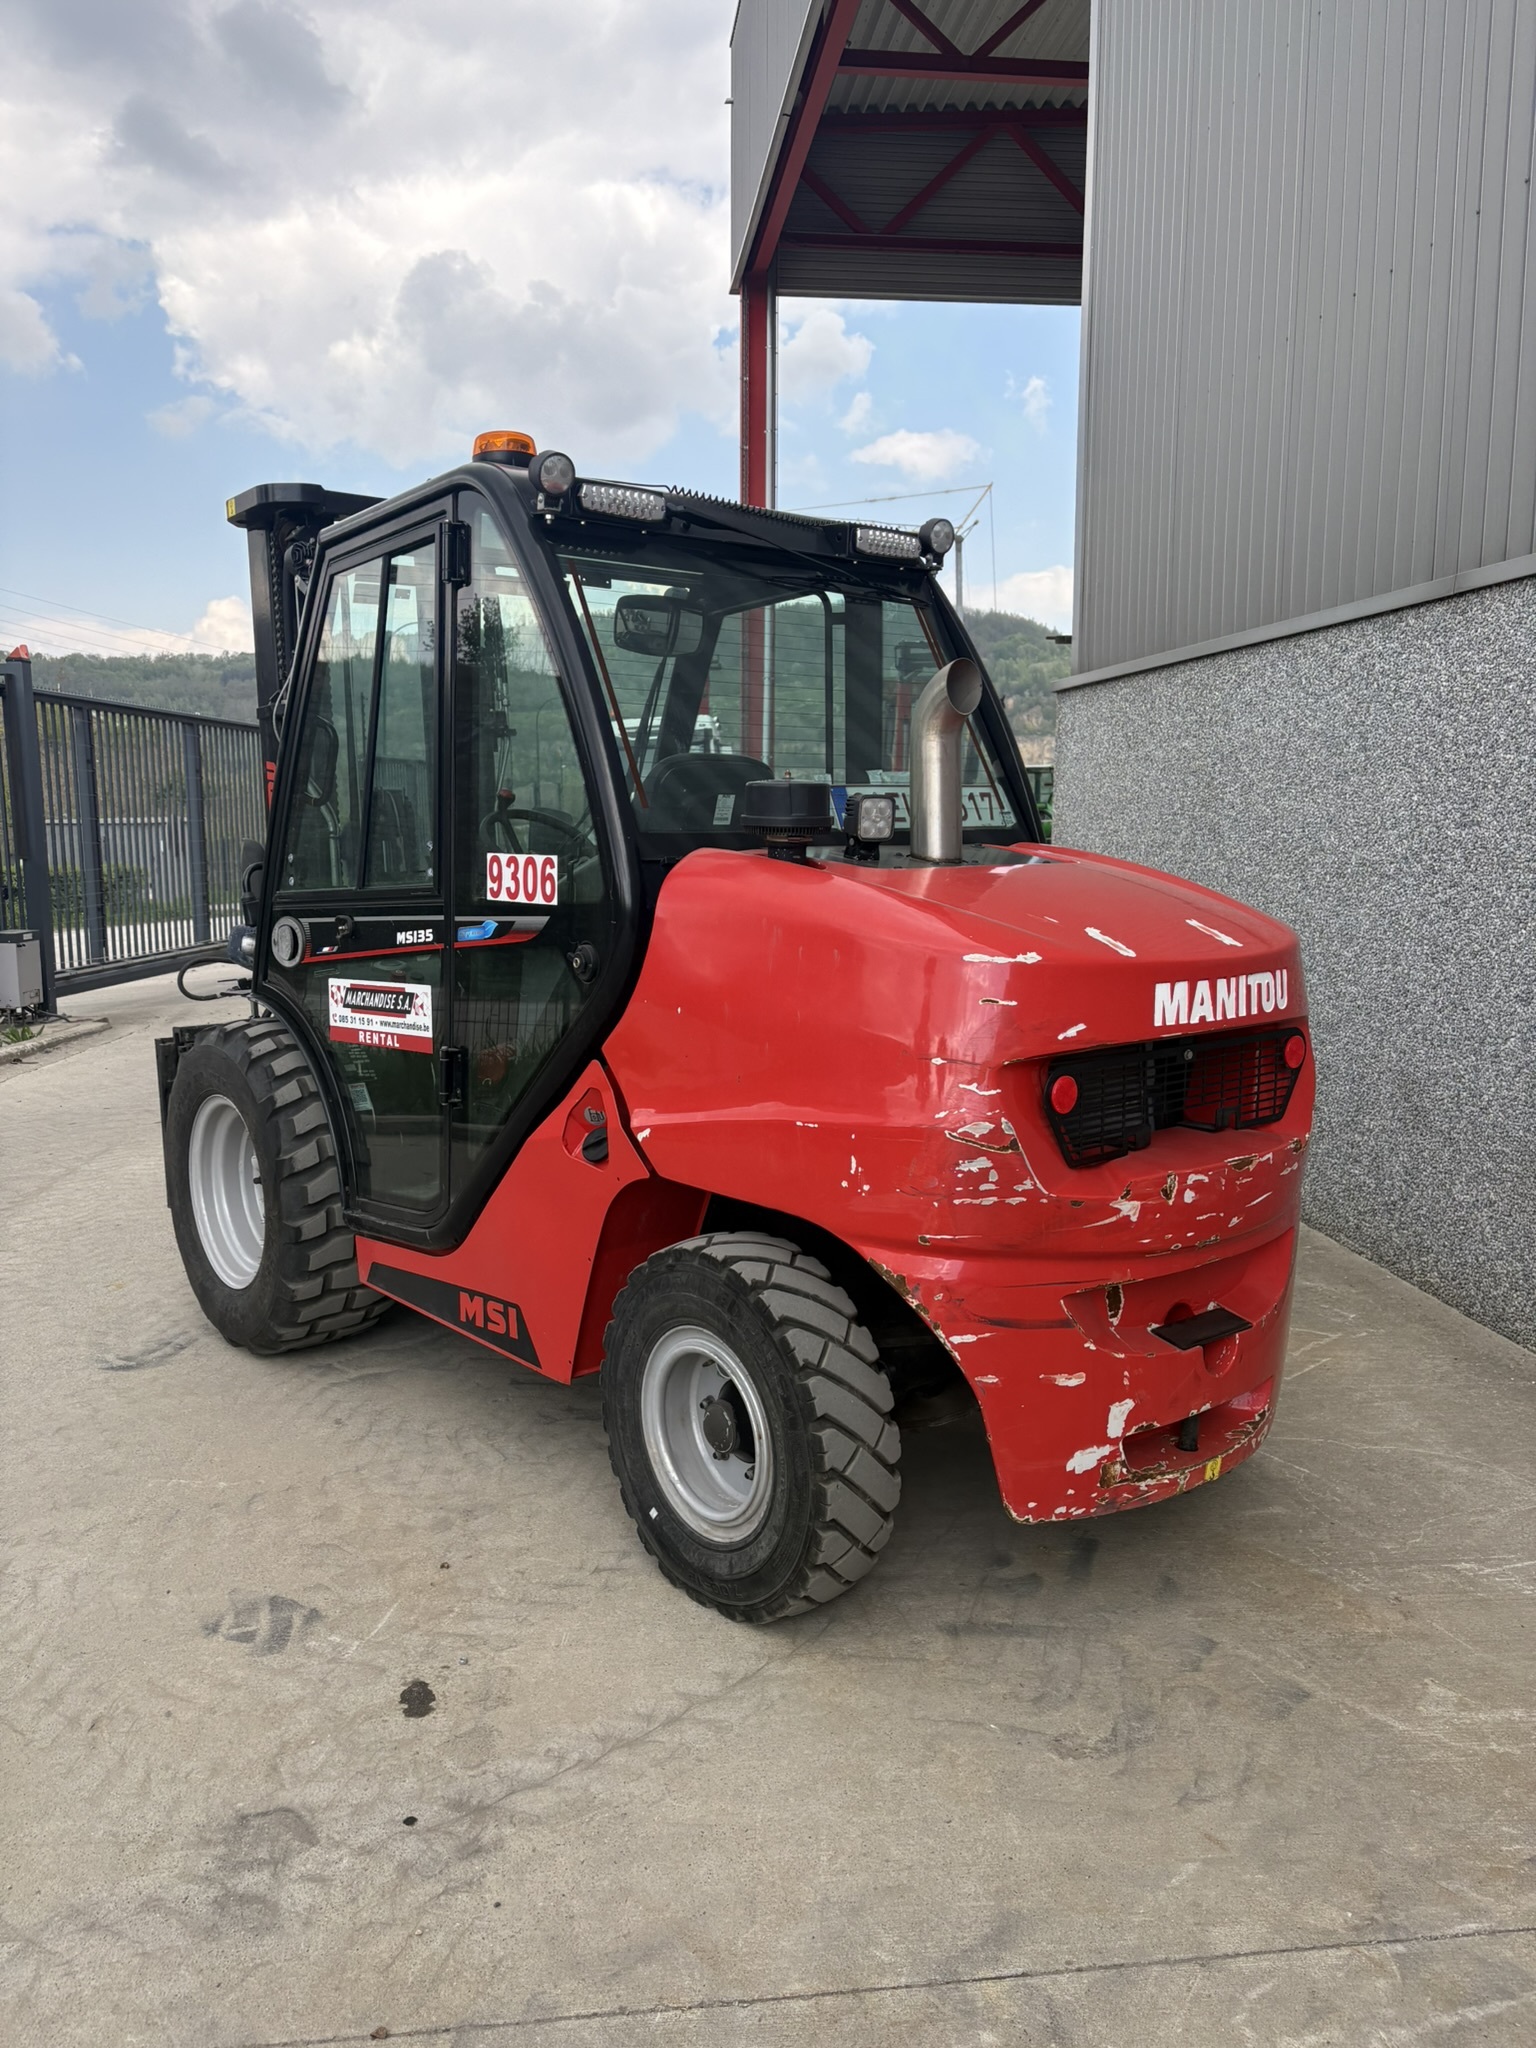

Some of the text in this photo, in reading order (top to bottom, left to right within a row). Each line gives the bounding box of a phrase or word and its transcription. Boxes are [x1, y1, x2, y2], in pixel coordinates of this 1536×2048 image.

[489, 855, 556, 903] 9306
[345, 991, 411, 1010] MARCHANDISE S.A.
[1154, 969, 1287, 1027] MANITOU
[339, 1015, 430, 1032] 085 31 15 91 www.marchandise.be
[359, 1031, 400, 1047] RENTAL
[460, 1291, 518, 1340] MSI
